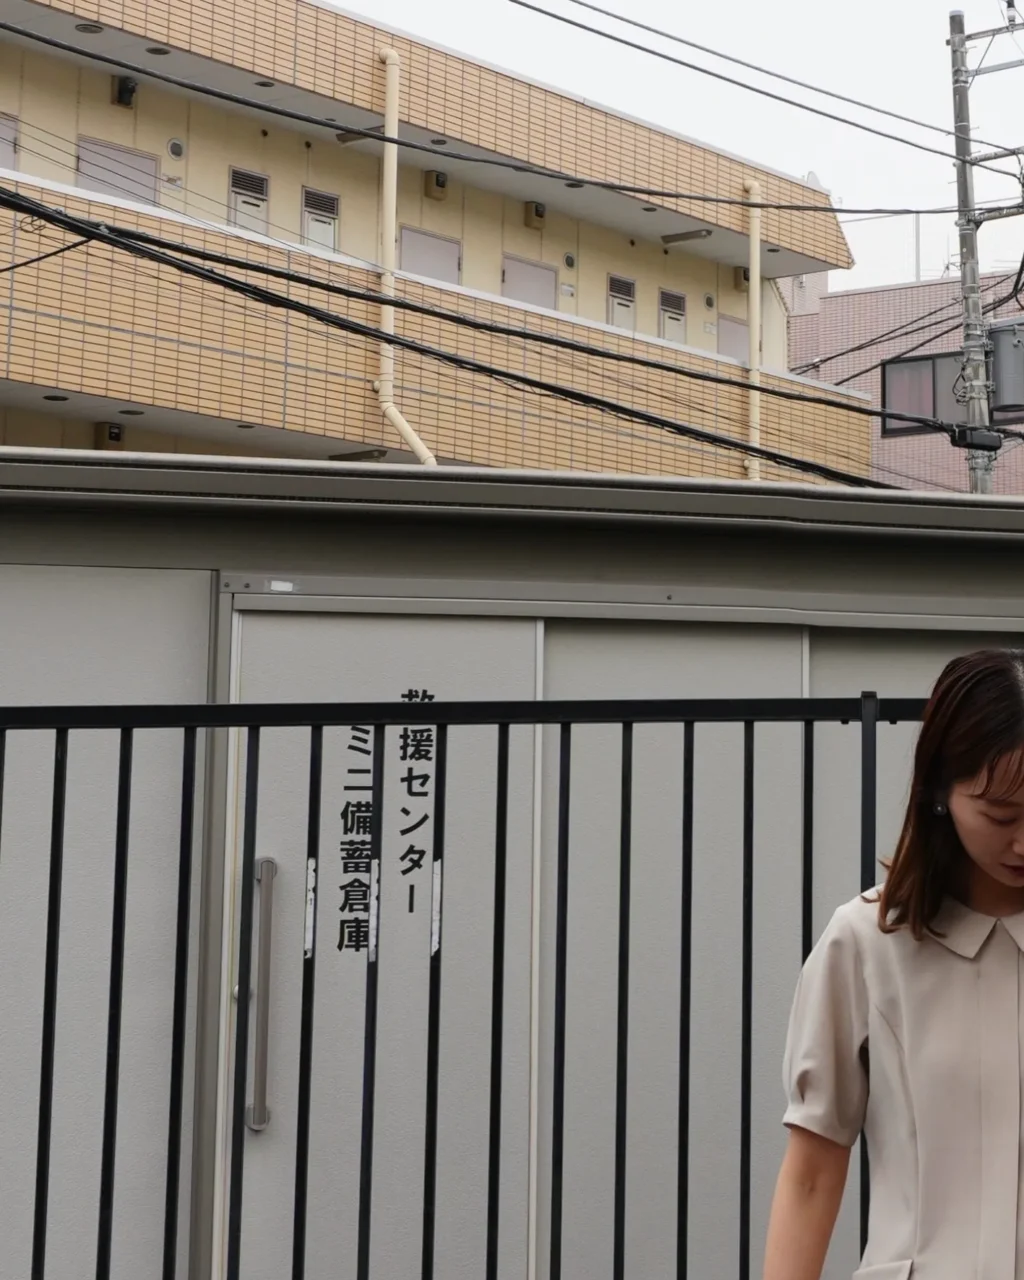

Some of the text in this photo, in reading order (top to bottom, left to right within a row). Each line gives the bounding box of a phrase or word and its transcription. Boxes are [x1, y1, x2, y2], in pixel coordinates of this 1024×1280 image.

[337, 725, 373, 952] ミニ備蓄倉庫
